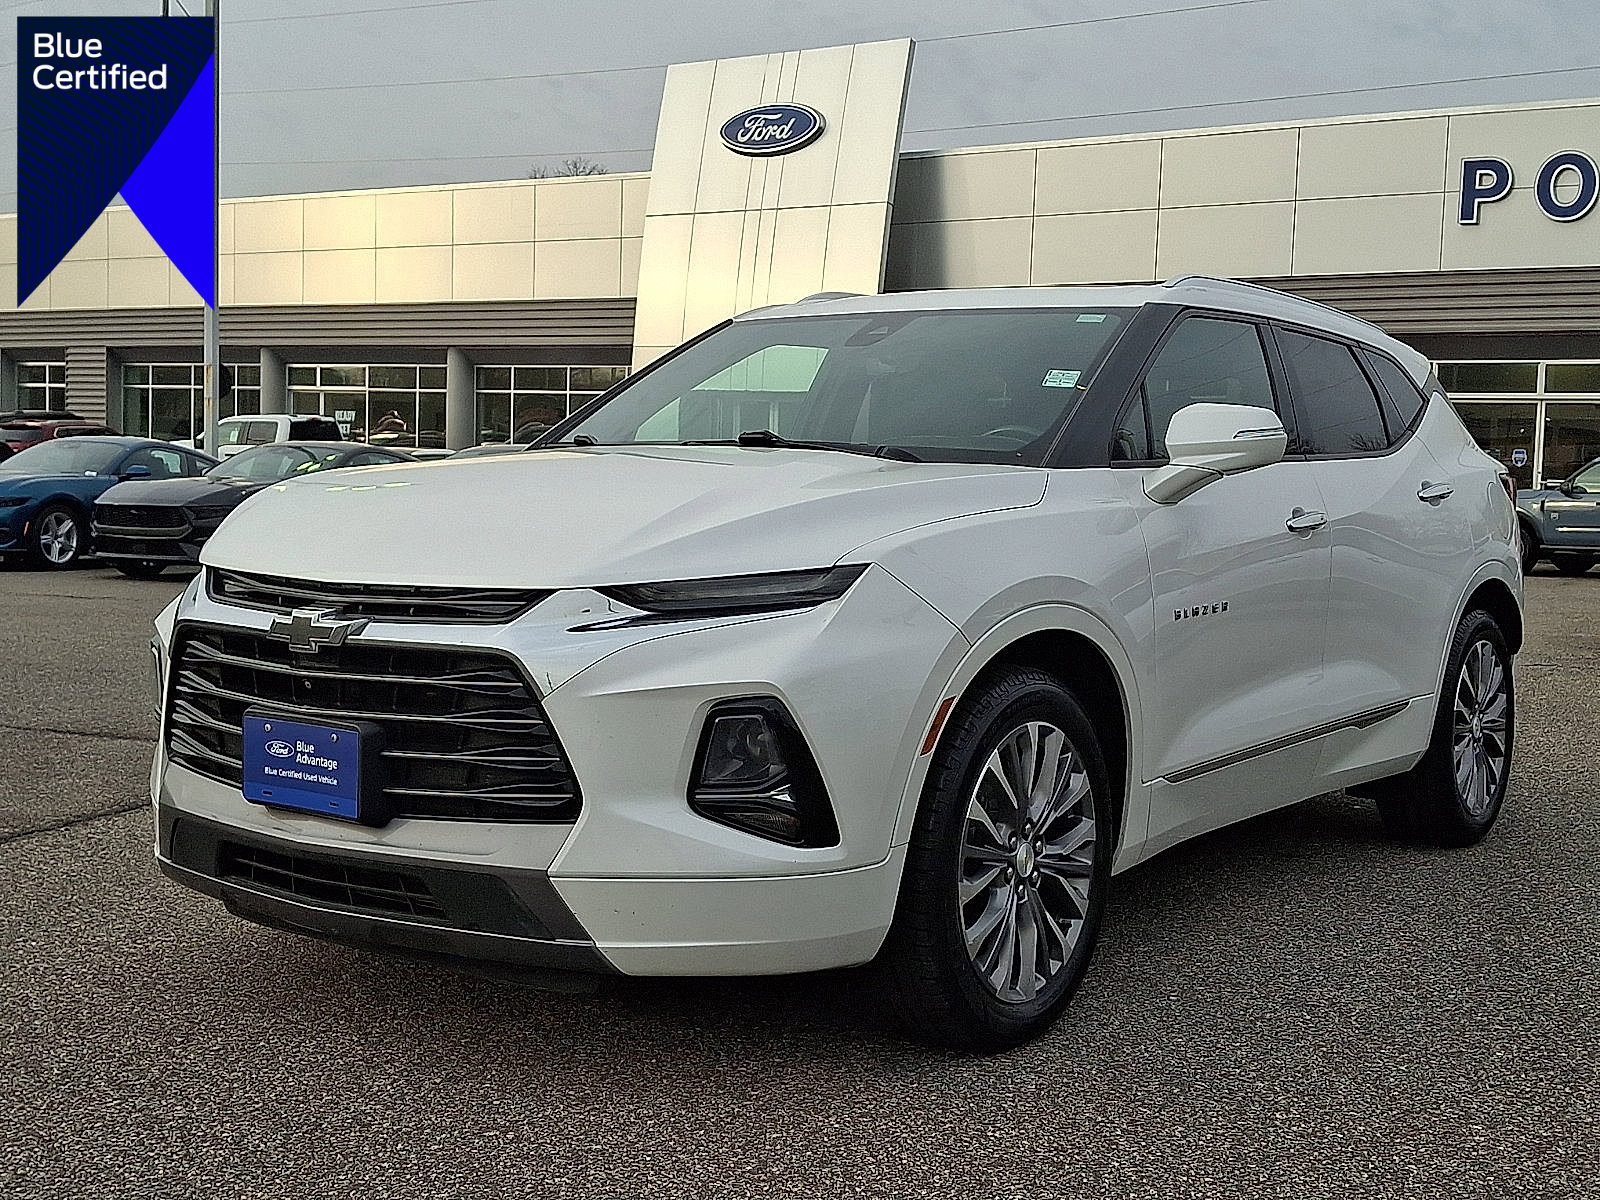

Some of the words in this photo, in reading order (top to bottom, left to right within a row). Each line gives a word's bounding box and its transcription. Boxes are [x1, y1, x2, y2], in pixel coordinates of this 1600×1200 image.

[737, 113, 797, 143] Ford
[1173, 601, 1229, 622] BLAZER
[270, 742, 289, 755] Ford
[296, 741, 315, 753] Blue
[295, 753, 338, 770] Advantage
[264, 766, 278, 776] Blue
[278, 768, 303, 780] Certified
[302, 771, 318, 783] Used
[318, 775, 338, 786] Vehicle
